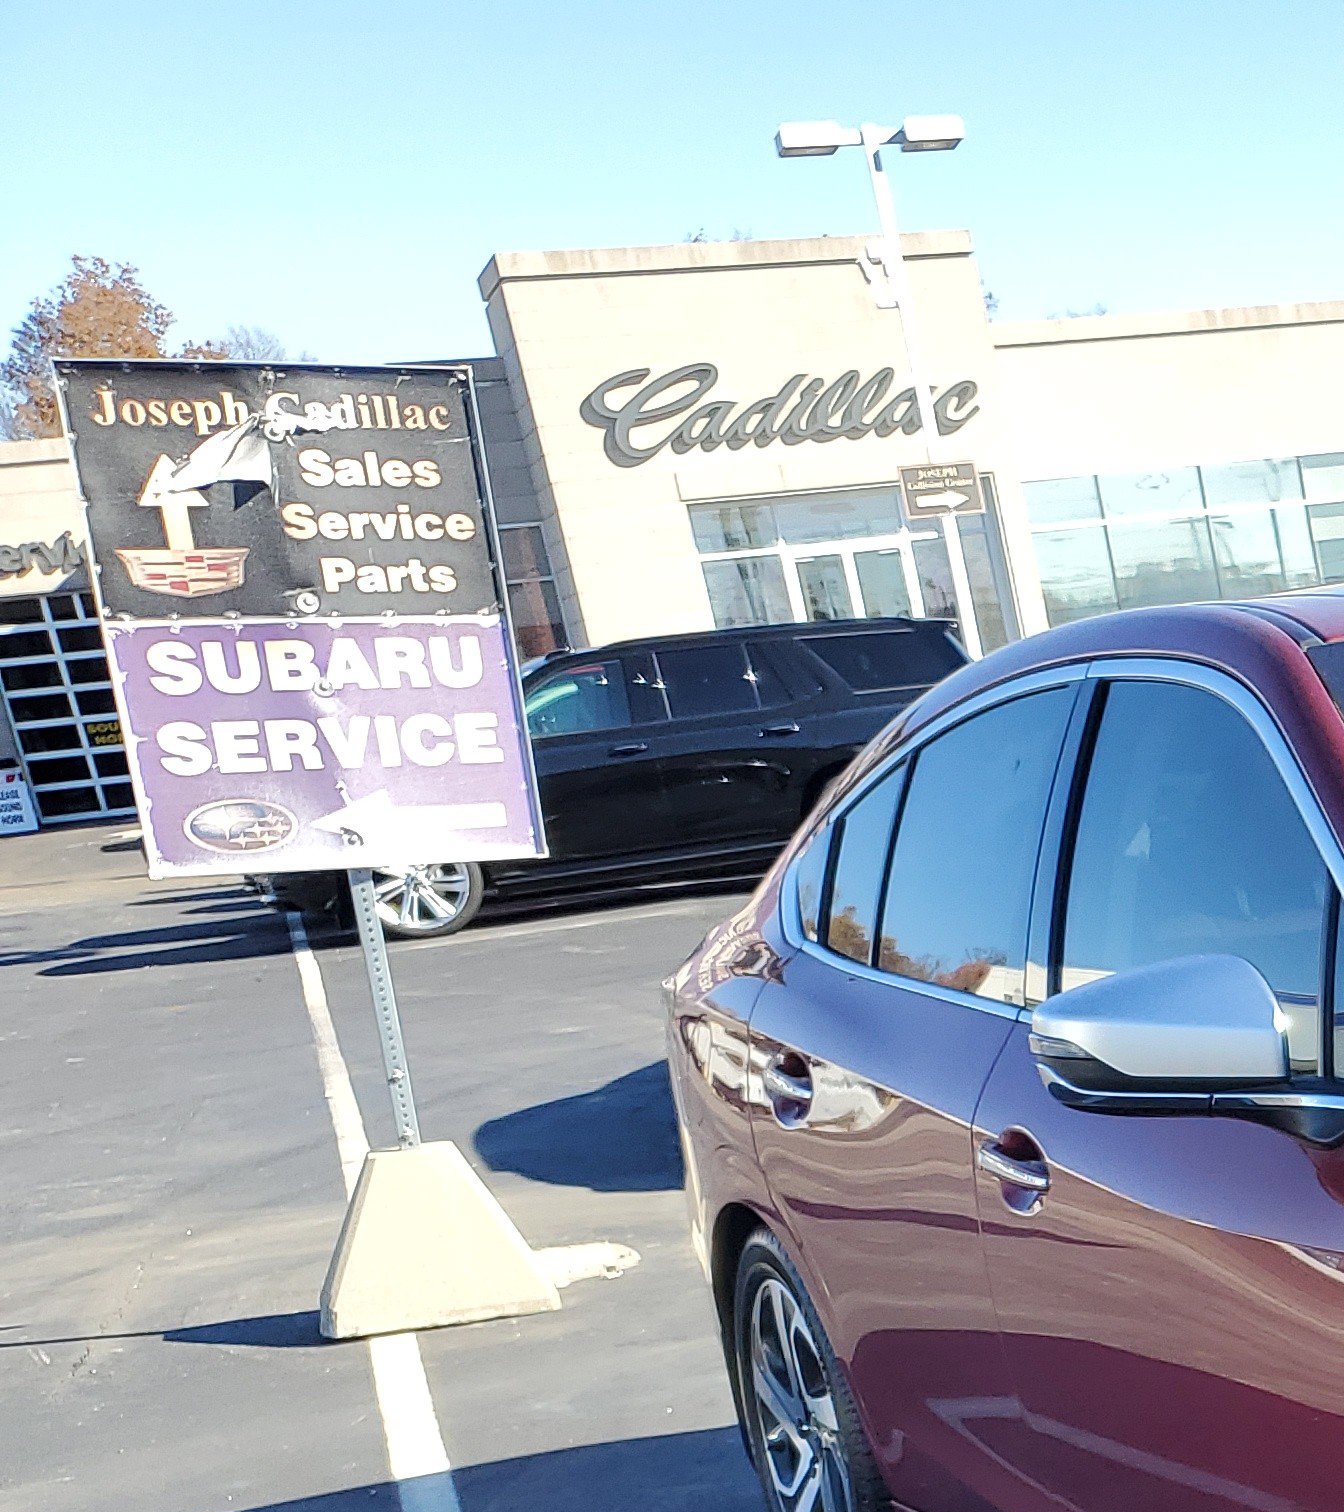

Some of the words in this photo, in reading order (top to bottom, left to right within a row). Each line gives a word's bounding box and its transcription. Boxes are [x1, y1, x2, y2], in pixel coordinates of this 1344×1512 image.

[93, 387, 249, 436] Joseph
[579, 362, 981, 468] Cadillac
[298, 448, 442, 489] Sales
[280, 501, 476, 542] Service
[319, 555, 457, 595] Parts
[145, 635, 484, 697] SUBARU
[155, 711, 505, 777] SERVICE
